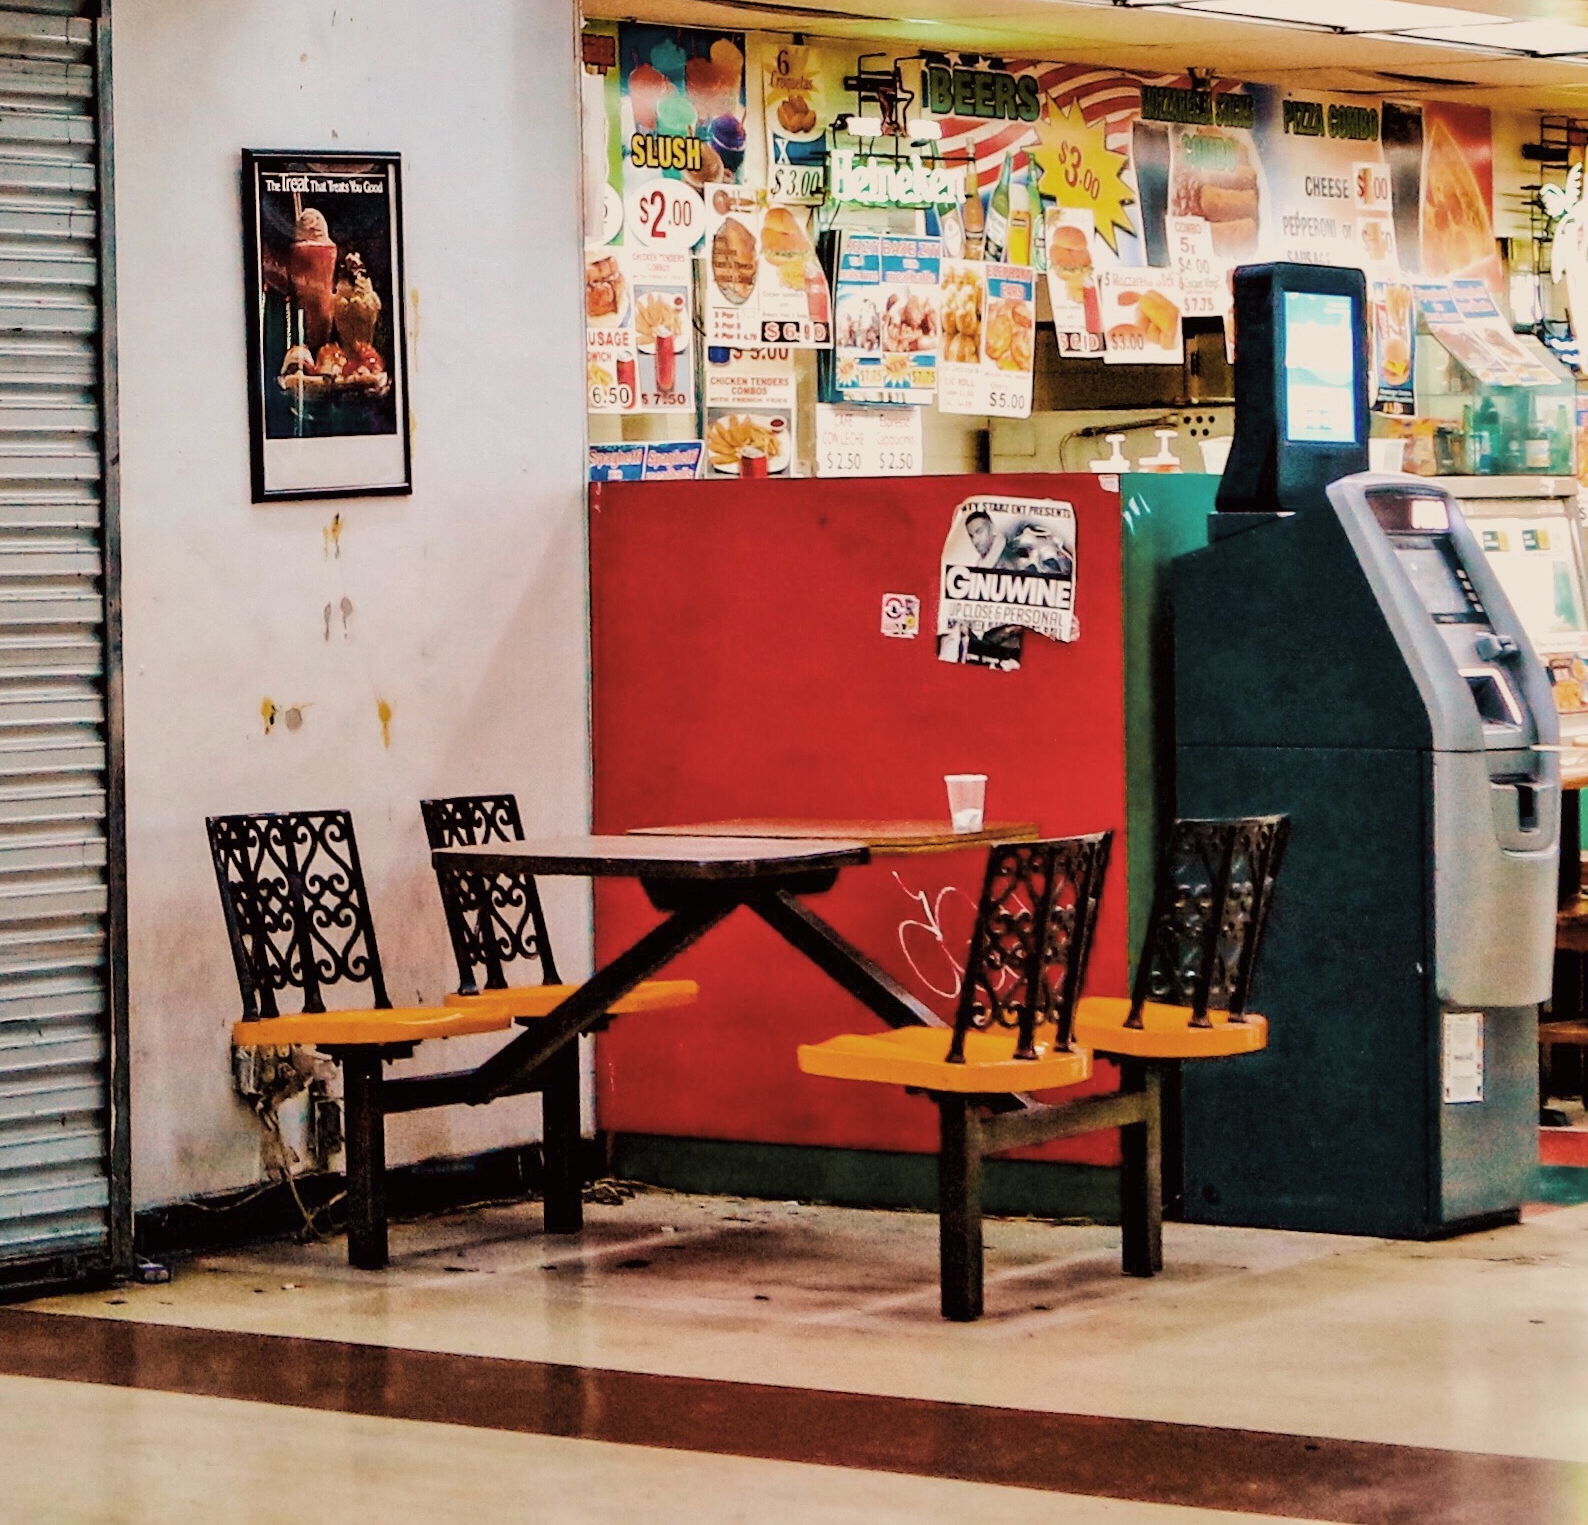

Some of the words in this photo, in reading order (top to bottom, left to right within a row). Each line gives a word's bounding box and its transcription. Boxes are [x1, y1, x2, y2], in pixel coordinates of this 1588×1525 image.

[928, 64, 1041, 122] BEERS
[1282, 99, 1325, 137] PIZZA
[1327, 102, 1380, 142] COMBO
[630, 132, 703, 171] SLUSH
[265, 180, 281, 192] The
[279, 173, 309, 193] Treat
[363, 180, 384, 194] Good
[830, 148, 967, 204] Heineken
[1304, 175, 1350, 200] CHEESE
[639, 189, 692, 239] $2.00
[587, 331, 629, 347] USAGE
[710, 377, 748, 385] CHICKEN
[750, 377, 789, 386] TENDERS
[731, 386, 768, 395] COMBOS
[988, 391, 1026, 410] $5.00
[1029, 506, 1071, 519] PRESENTS
[946, 565, 1072, 610] GINUWINE
[963, 603, 993, 620] CLOSE
[1004, 606, 1063, 627] PERSONAL
